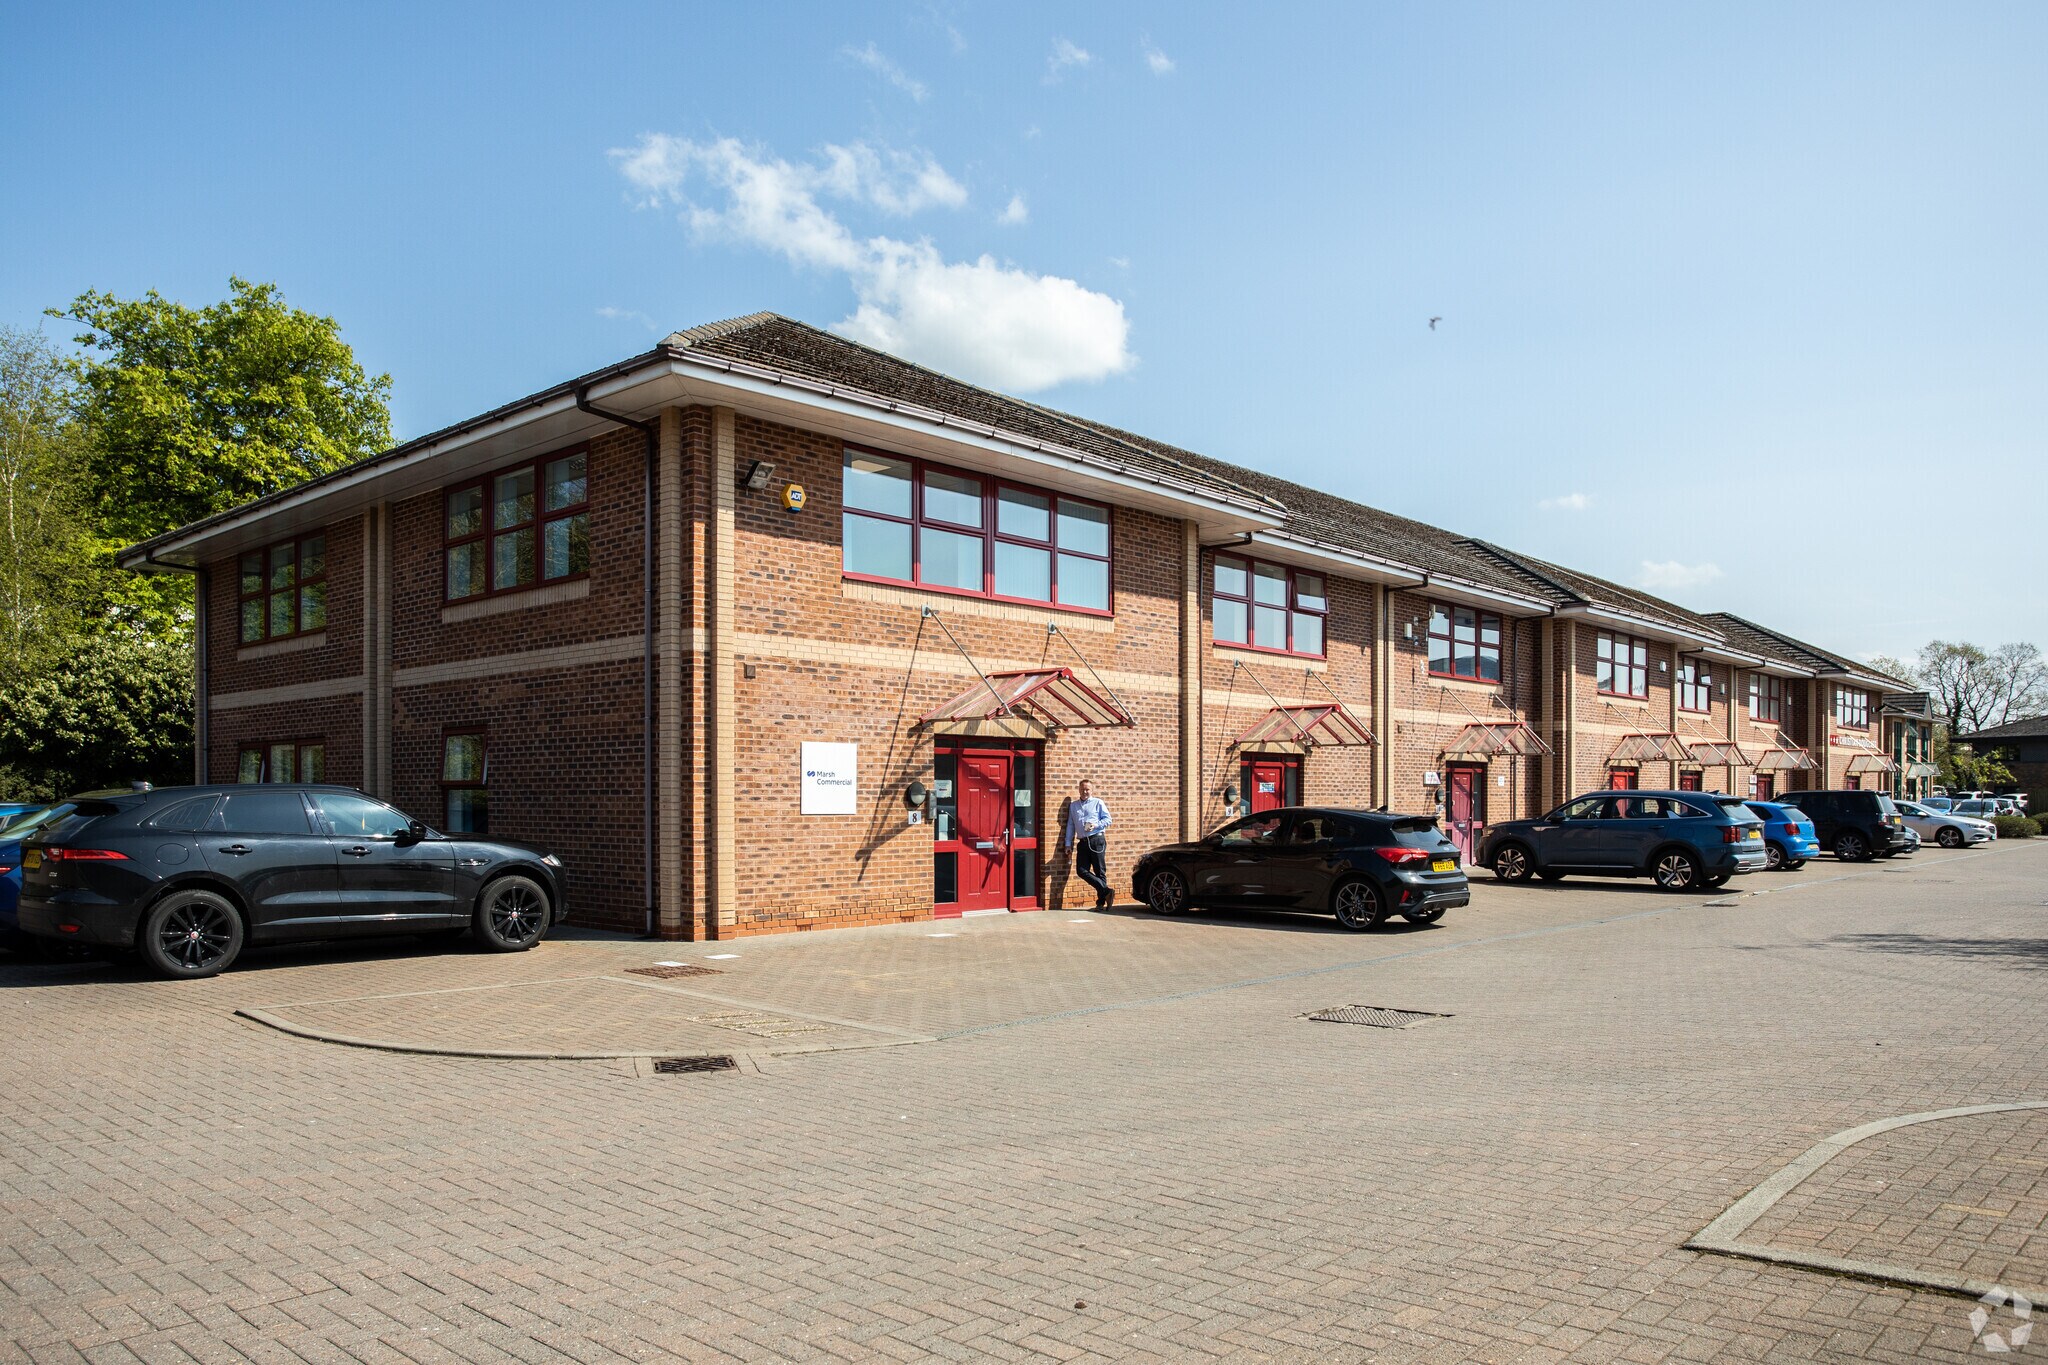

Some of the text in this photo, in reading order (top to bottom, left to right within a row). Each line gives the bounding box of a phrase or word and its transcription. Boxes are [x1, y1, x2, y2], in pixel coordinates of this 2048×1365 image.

[791, 492, 802, 500] ADT
[816, 778, 852, 786] Commercial
[912, 812, 918, 823] 8
